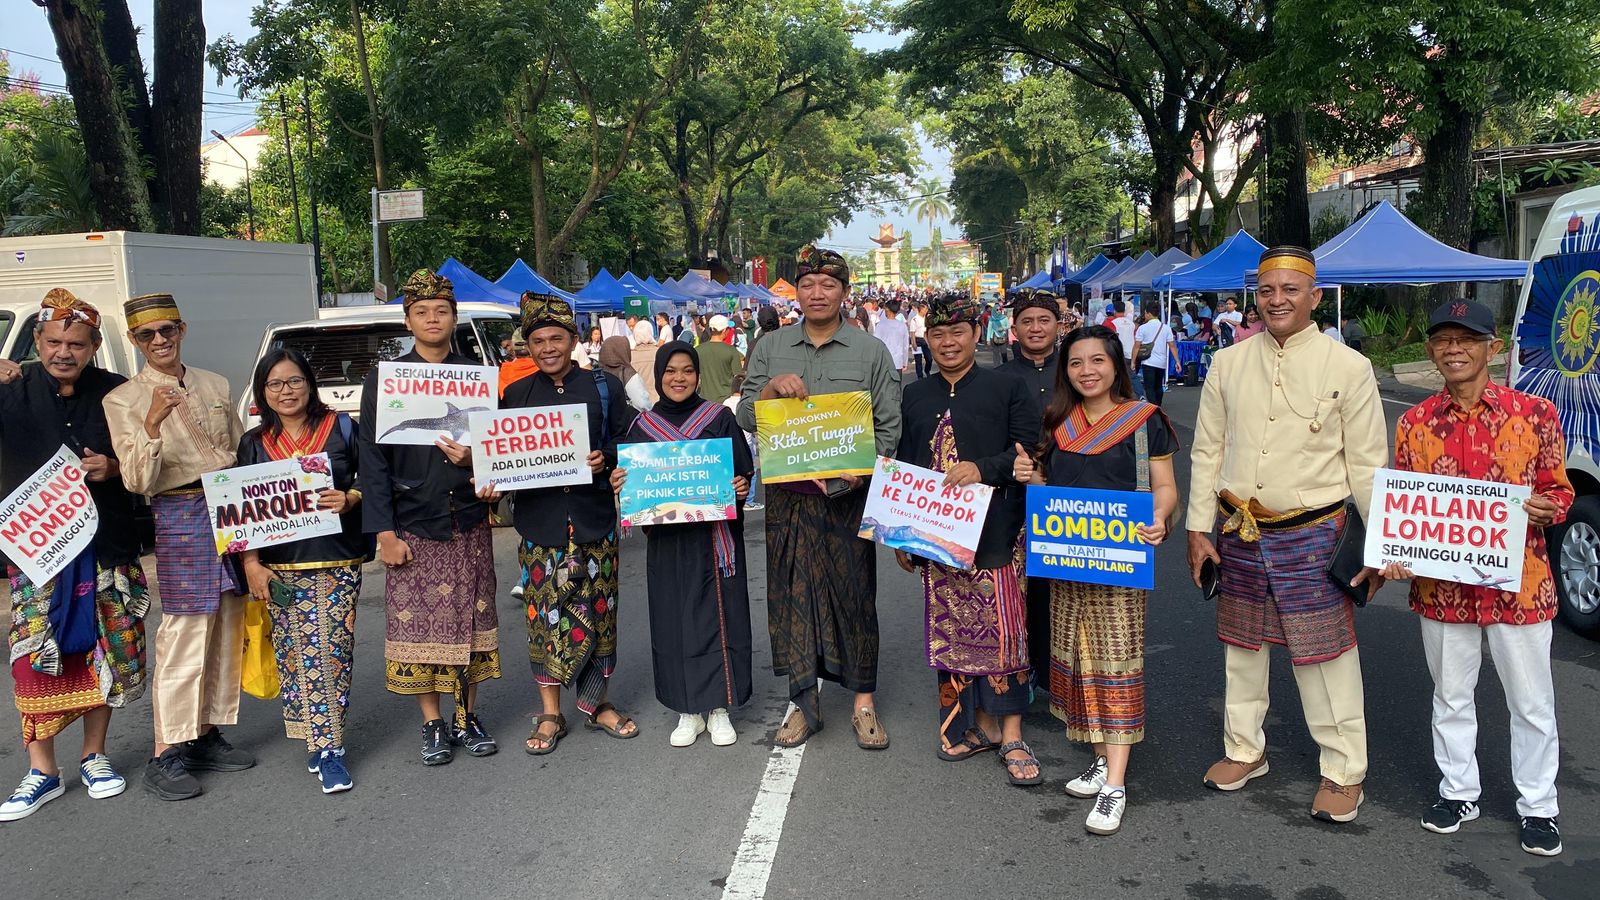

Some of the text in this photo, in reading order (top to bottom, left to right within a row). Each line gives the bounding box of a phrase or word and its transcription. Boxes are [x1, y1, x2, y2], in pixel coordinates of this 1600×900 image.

[395, 368, 481, 381] SEKALI-KALI KE
[384, 378, 490, 398] SUMBAWA
[487, 411, 565, 437] JODOH
[786, 410, 841, 427] POKOKNYA
[481, 429, 575, 457] TERBAIK
[769, 424, 865, 451] Kita Tunggu
[491, 452, 576, 472] ADA DI LOMBOK
[630, 454, 722, 469] SUAMI TERBAIK
[787, 443, 857, 465] DI LOMBOK
[15, 481, 42, 506] CUMA
[40, 455, 66, 484] SEKALI
[512, 473, 535, 483] BELUM
[537, 470, 563, 480] KESANA
[563, 468, 578, 477] AJA)
[644, 470, 709, 483] AJAK ISTRI
[241, 477, 298, 499] NONTON
[636, 484, 719, 499] PIKNIK KE GILI
[891, 471, 975, 503] DONG AYO
[1386, 478, 1508, 498] HIDUP CUMA SEKALI
[0, 465, 81, 544] MALANG
[882, 484, 976, 523] KE LOMBOK
[1045, 498, 1128, 518] JANGAN KE
[1384, 492, 1509, 523] MALANG
[235, 516, 321, 540] DI MANDALIKA
[890, 506, 955, 532] (TERUS KE SUMBAWA)
[1032, 513, 1146, 545] LOMBOK
[36, 511, 91, 569] SEMINGGU 4
[1382, 517, 1509, 550] LOMBOK
[1067, 545, 1106, 558] NANTI
[1382, 543, 1509, 568] SEMINGGU 4 KALI
[46, 565, 54, 575] PP
[1043, 555, 1135, 574] GA MAU PULANG
